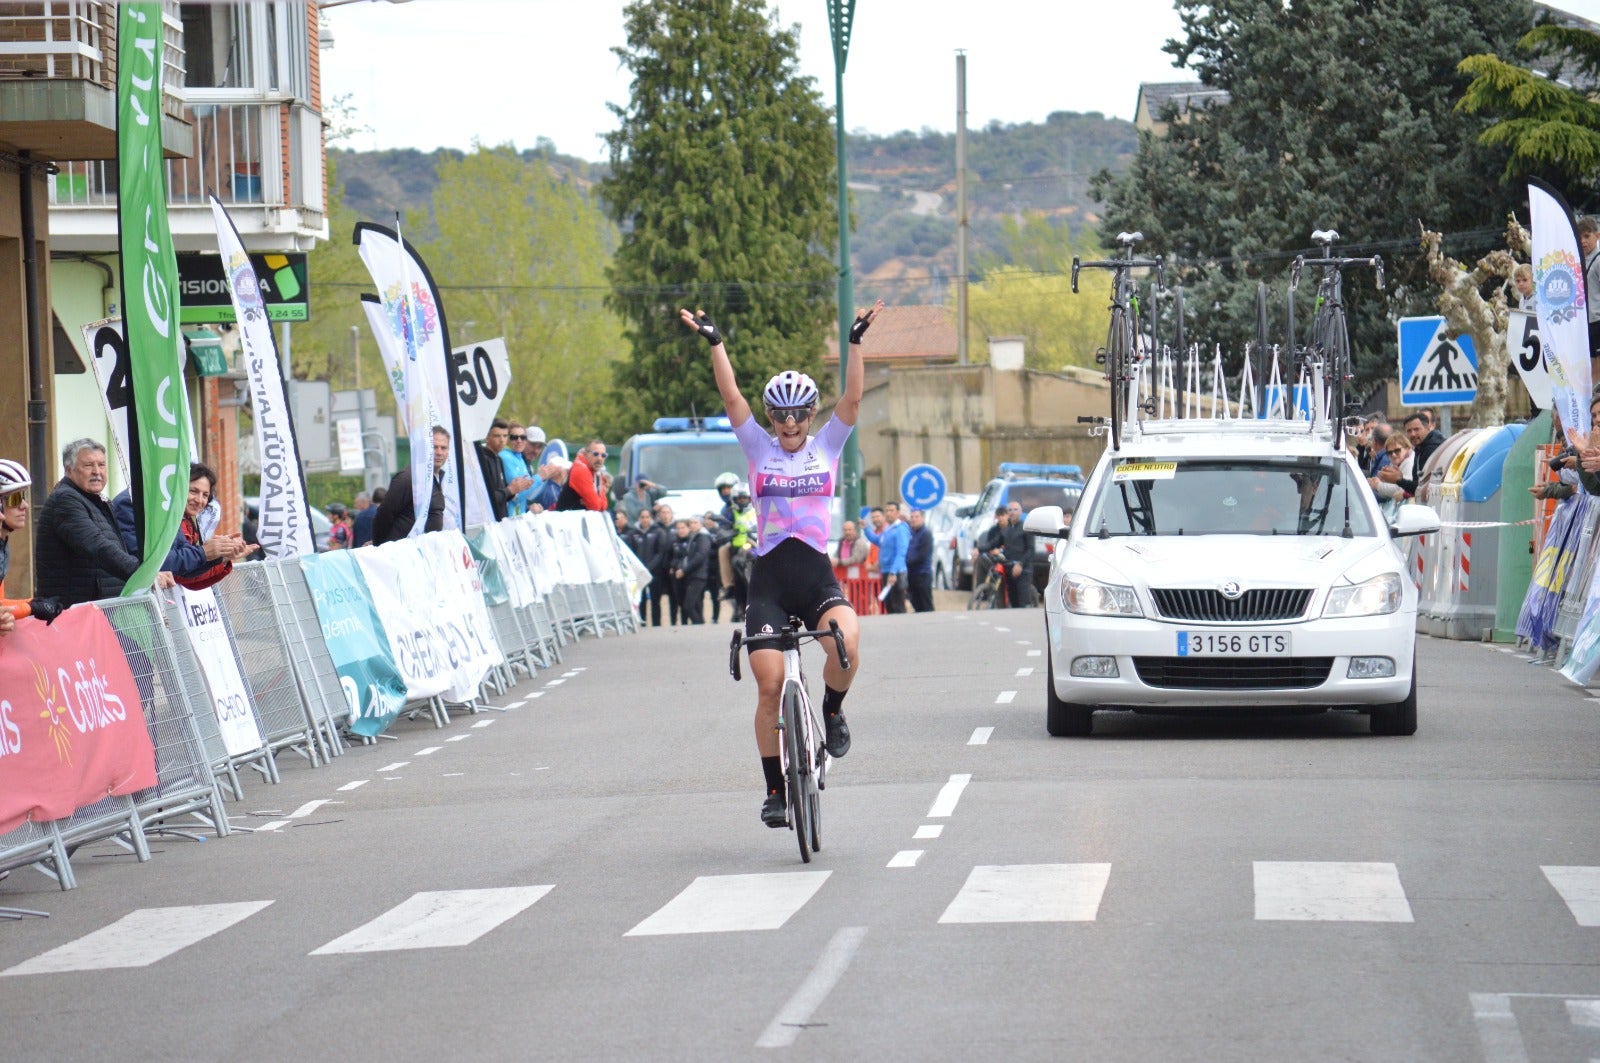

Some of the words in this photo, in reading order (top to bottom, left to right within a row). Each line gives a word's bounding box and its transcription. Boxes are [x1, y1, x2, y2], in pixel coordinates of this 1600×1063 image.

[275, 309, 289, 318] 24
[291, 308, 304, 317] 55
[452, 346, 498, 407] 50
[1116, 464, 1143, 472] COCHE
[763, 476, 824, 488] LABORAL
[1192, 635, 1242, 653] 3156
[1249, 635, 1285, 653] GTS
